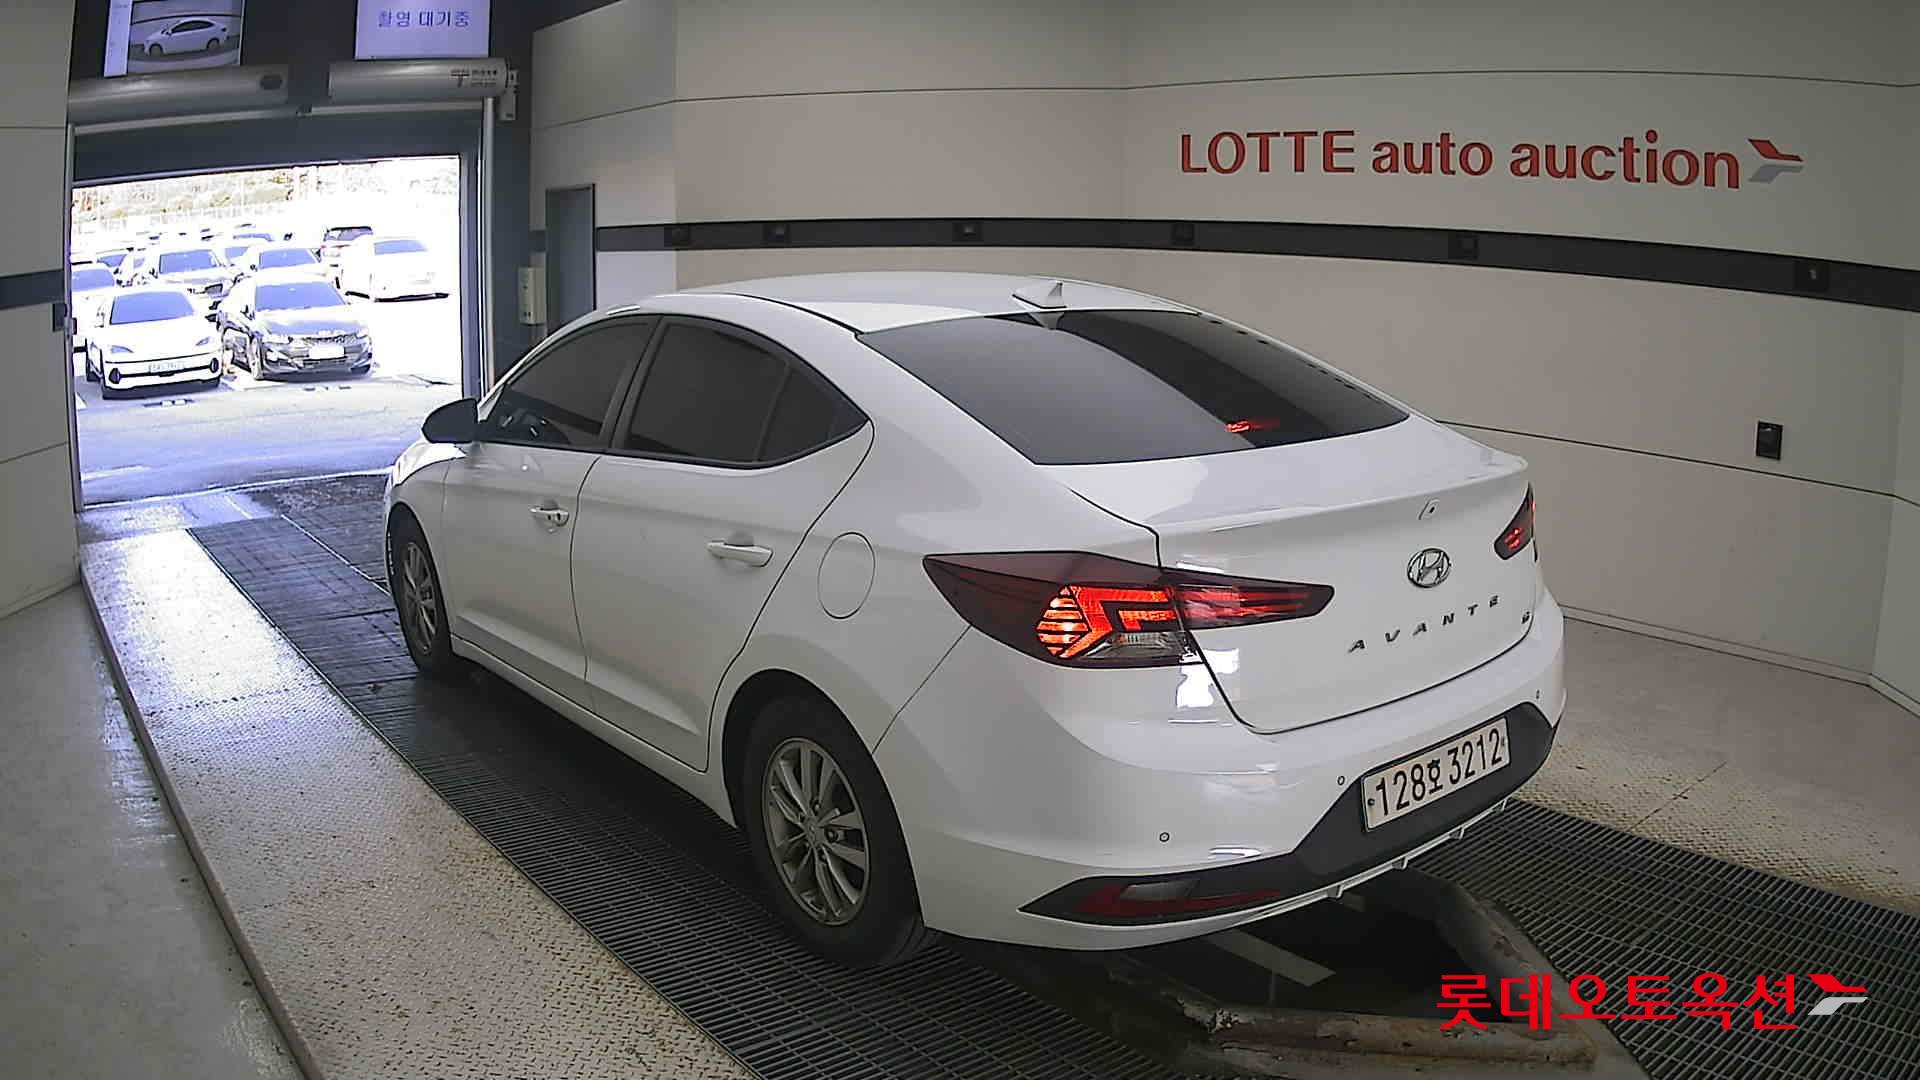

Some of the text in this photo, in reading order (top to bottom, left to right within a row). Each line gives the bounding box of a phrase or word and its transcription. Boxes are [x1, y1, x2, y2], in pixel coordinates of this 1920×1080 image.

[419, 10, 469, 28] 대기중
[1179, 130, 1741, 190] LOTTE auto auction
[1347, 594, 1500, 654] AVANTE
[1375, 727, 1504, 817] 128호 3212
